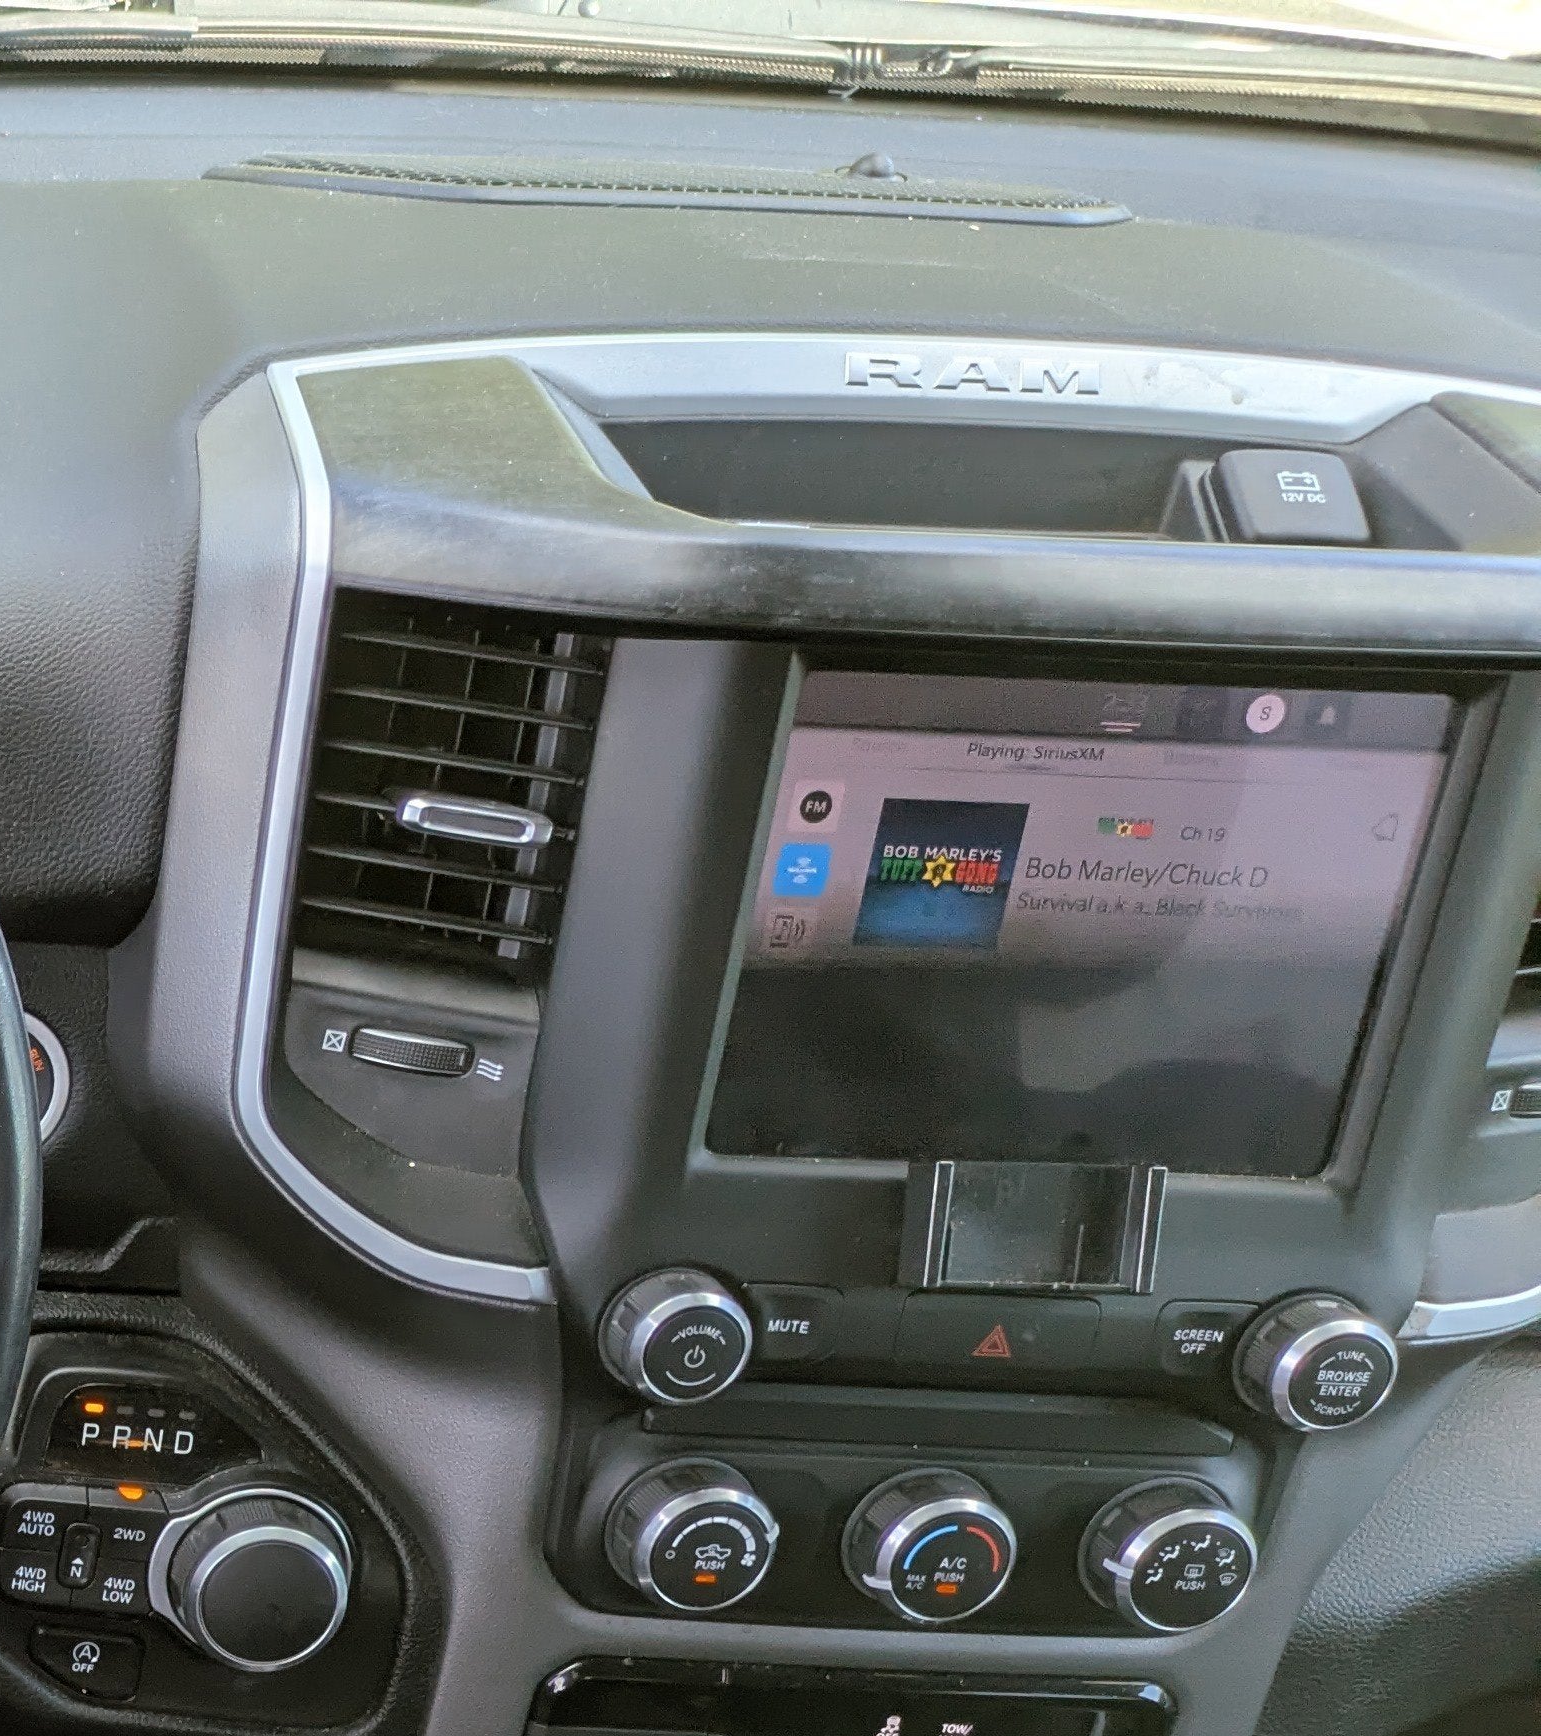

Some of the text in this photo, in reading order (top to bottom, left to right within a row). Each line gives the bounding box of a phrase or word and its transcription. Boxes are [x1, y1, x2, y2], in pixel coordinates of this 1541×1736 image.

[844, 352, 1100, 395] RAM
[1281, 492, 1326, 503] 12V DC
[1259, 706, 1272, 721] S
[1034, 746, 1105, 762] SiriusXM
[805, 800, 827, 814] FM
[1180, 826, 1226, 842] Ch 19
[883, 844, 1003, 862] BOB MARLEY'S
[1025, 857, 1268, 888] Bob Marley/Chuck D
[962, 884, 995, 895] RADIO
[1017, 892, 1093, 914] Survival
[1155, 899, 1205, 918] Black
[677, 1325, 721, 1341] VOLUME
[768, 1319, 811, 1335] MUTE
[1173, 1329, 1225, 1343] SCREEN
[1181, 1343, 1206, 1355] OFF
[1337, 1351, 1366, 1363] TUNE
[1317, 1370, 1372, 1382] BROWSE
[1319, 1385, 1362, 1398] ENTER
[1314, 1402, 1355, 1416] SCROLL
[81, 1423, 194, 1455] P R N D
[22, 1510, 55, 1524] 4WD
[18, 1522, 55, 1537] AUTO
[113, 1528, 146, 1542] 2WD
[695, 1560, 726, 1571] PUSH
[939, 1556, 967, 1570] A/C
[15, 1566, 46, 1581] 4WD
[70, 1565, 83, 1578] N
[906, 1574, 927, 1583] MAX
[933, 1572, 965, 1582] PUSH
[11, 1578, 45, 1594] HIGH
[103, 1577, 135, 1592] 4WD
[906, 1581, 924, 1590] A/C
[1175, 1580, 1206, 1591] PUSH
[102, 1589, 134, 1604] LOW
[72, 1662, 94, 1673] OFF
[941, 1723, 974, 1735] TOW/
